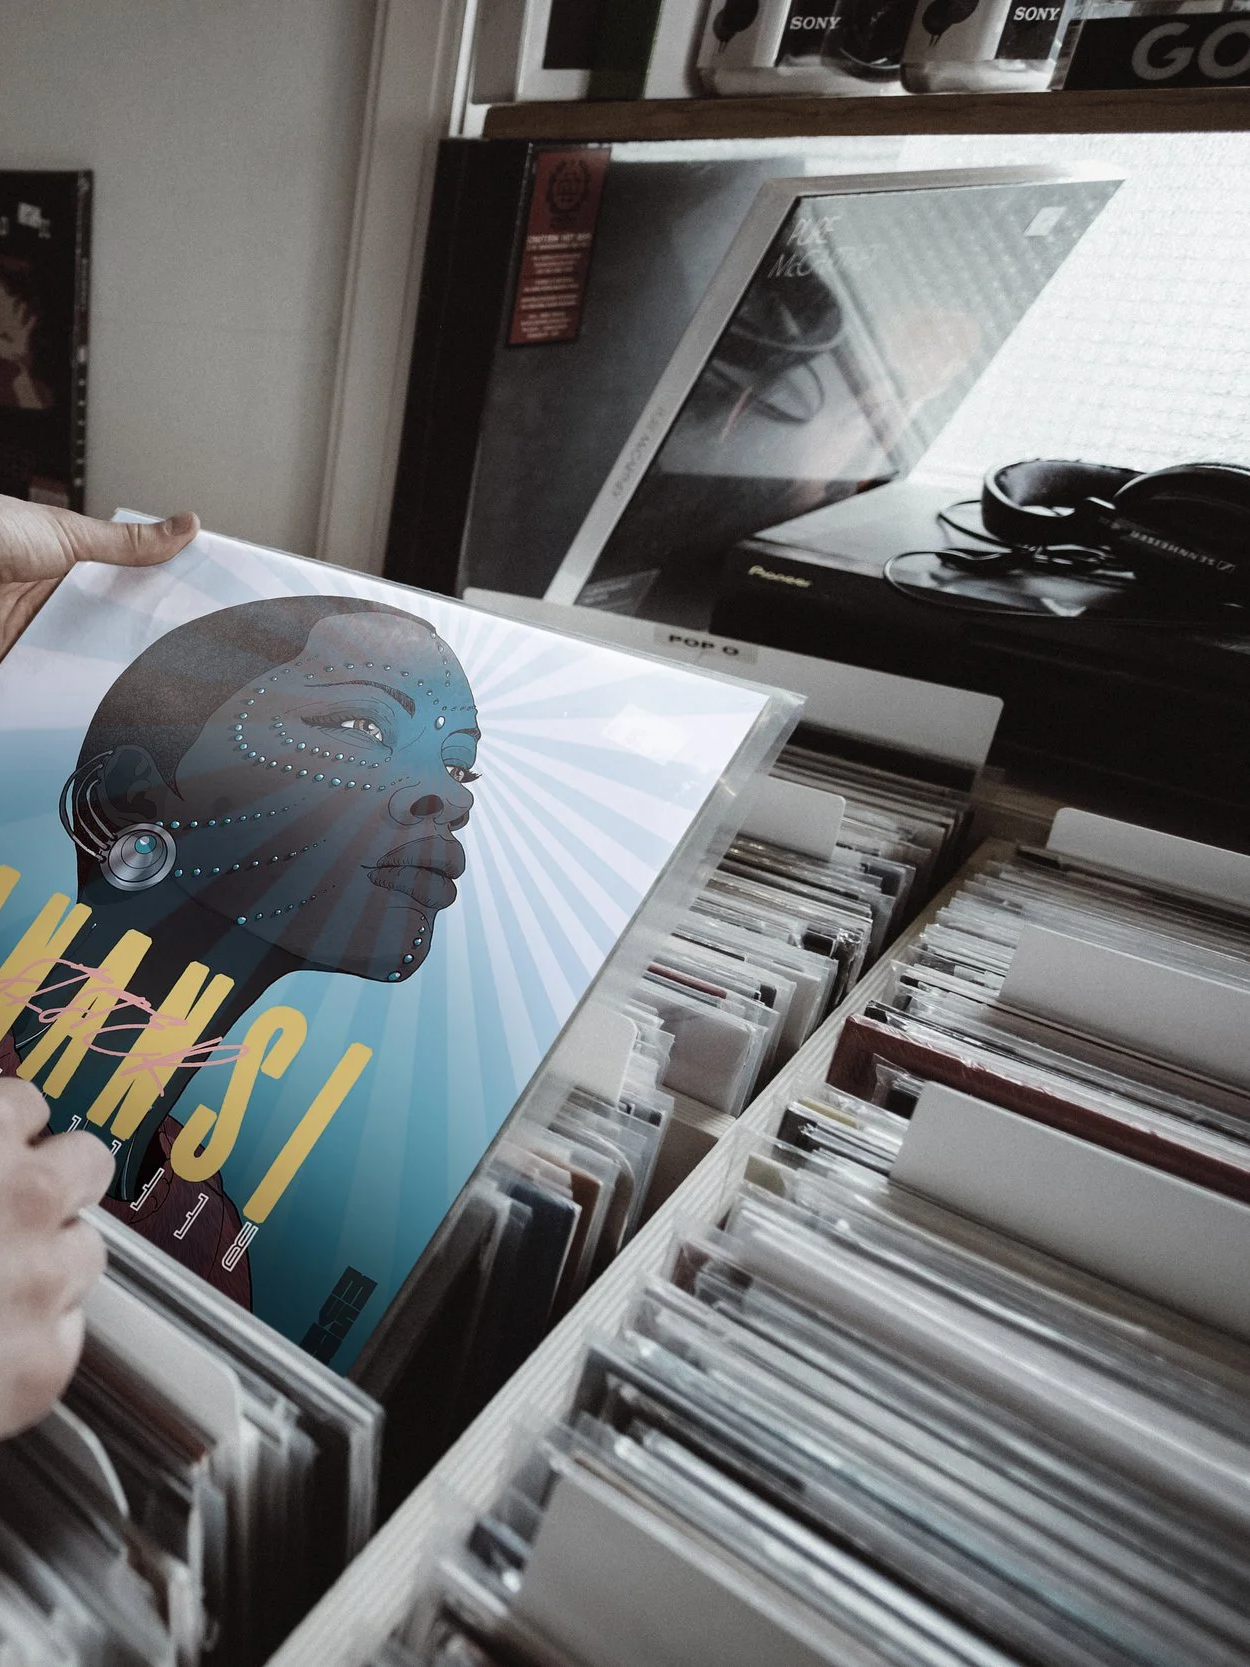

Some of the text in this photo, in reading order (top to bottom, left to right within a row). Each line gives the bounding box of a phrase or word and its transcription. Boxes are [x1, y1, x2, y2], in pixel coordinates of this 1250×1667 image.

[1013, 6, 1061, 21] SONY
[789, 16, 841, 30] SONY
[668, 634, 739, 656] POP O
